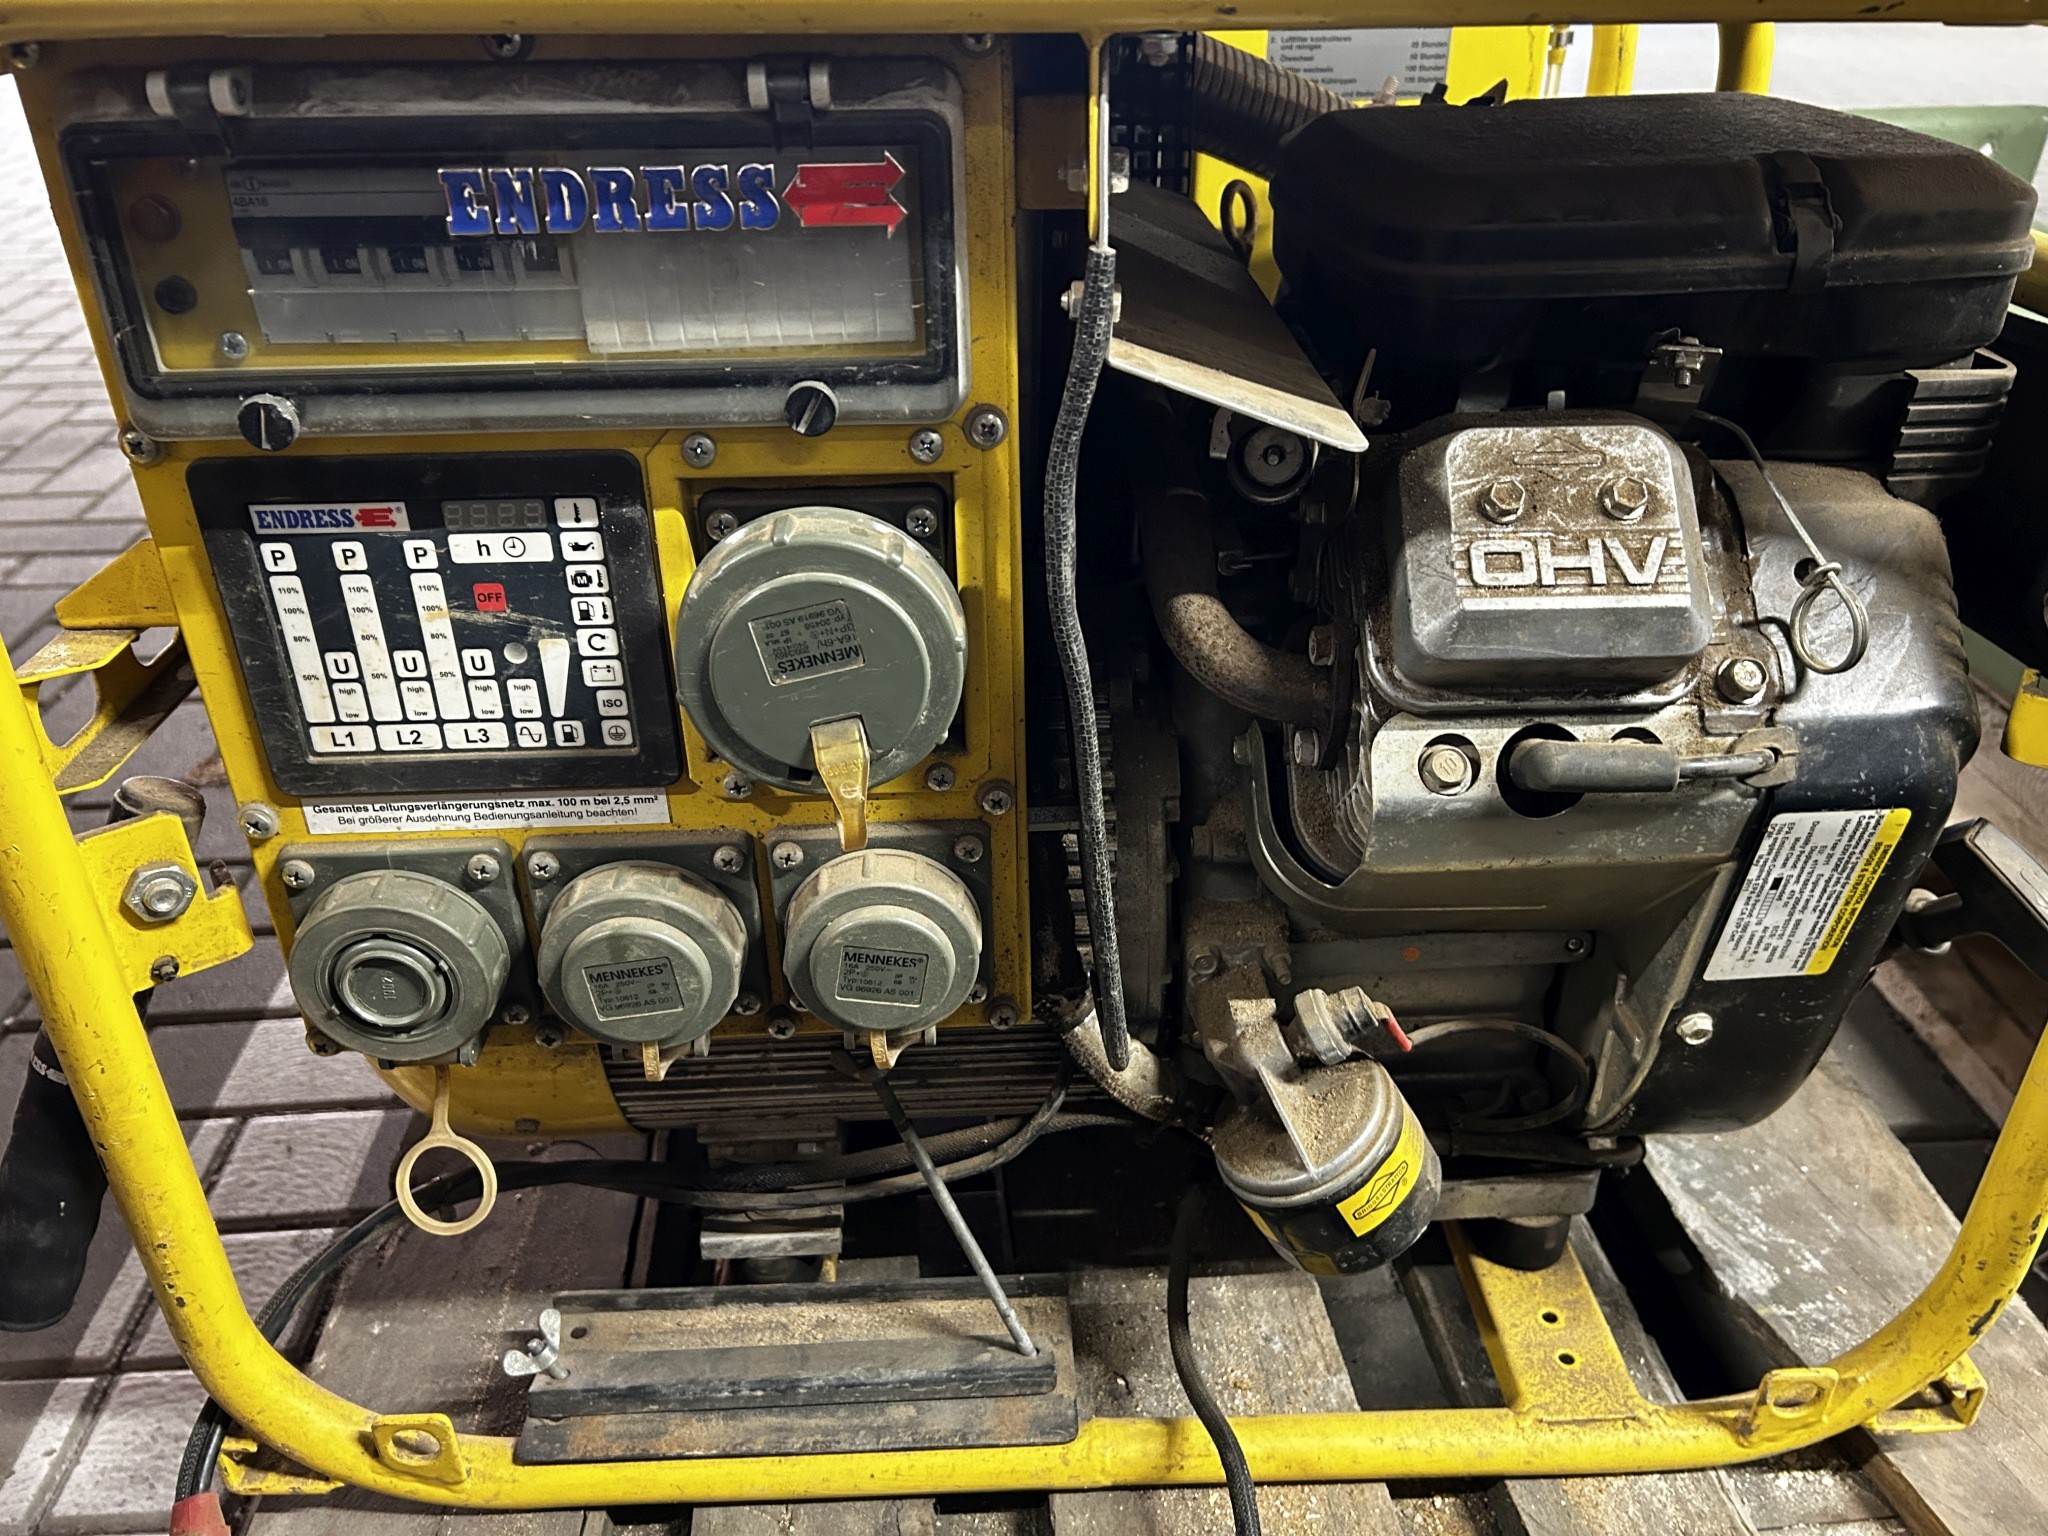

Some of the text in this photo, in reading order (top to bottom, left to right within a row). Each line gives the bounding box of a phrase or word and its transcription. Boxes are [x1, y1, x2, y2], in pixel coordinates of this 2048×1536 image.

[437, 162, 781, 236] ENDRESS
[255, 508, 355, 530] ENDRESS
[342, 548, 356, 565] P
[413, 547, 428, 563] P
[477, 540, 491, 557] h
[271, 549, 286, 567] P
[1469, 536, 1668, 586] OHV
[477, 592, 503, 603] OFF
[283, 607, 305, 615] 100%
[352, 606, 373, 614] 100%
[333, 658, 349, 674] U
[402, 657, 418, 673] U
[470, 655, 486, 671] U
[602, 699, 623, 708] ISO
[331, 731, 356, 747] L1
[396, 730, 423, 745] L2
[464, 729, 490, 744] L3
[313, 802, 370, 814] Gesamtes
[372, 800, 525, 812] Leitungsverlängerungsnetz
[528, 800, 555, 808] max.
[558, 798, 576, 807] 100
[594, 796, 610, 806] bei
[614, 796, 630, 806] 2,5
[634, 795, 658, 804] mm²
[338, 808, 638, 826] Bei größerer Ausdehnung Bedienungsanleitung beachten!
[1864, 842, 1882, 866] BRIGGS
[1831, 844, 1891, 947] EMISSION CONTROL INFORMATION
[1843, 874, 1865, 906] STRATTON
[1819, 907, 1847, 950] CORPORATION
[844, 952, 917, 967] MENNEKES
[588, 965, 663, 984] MENNEKES
